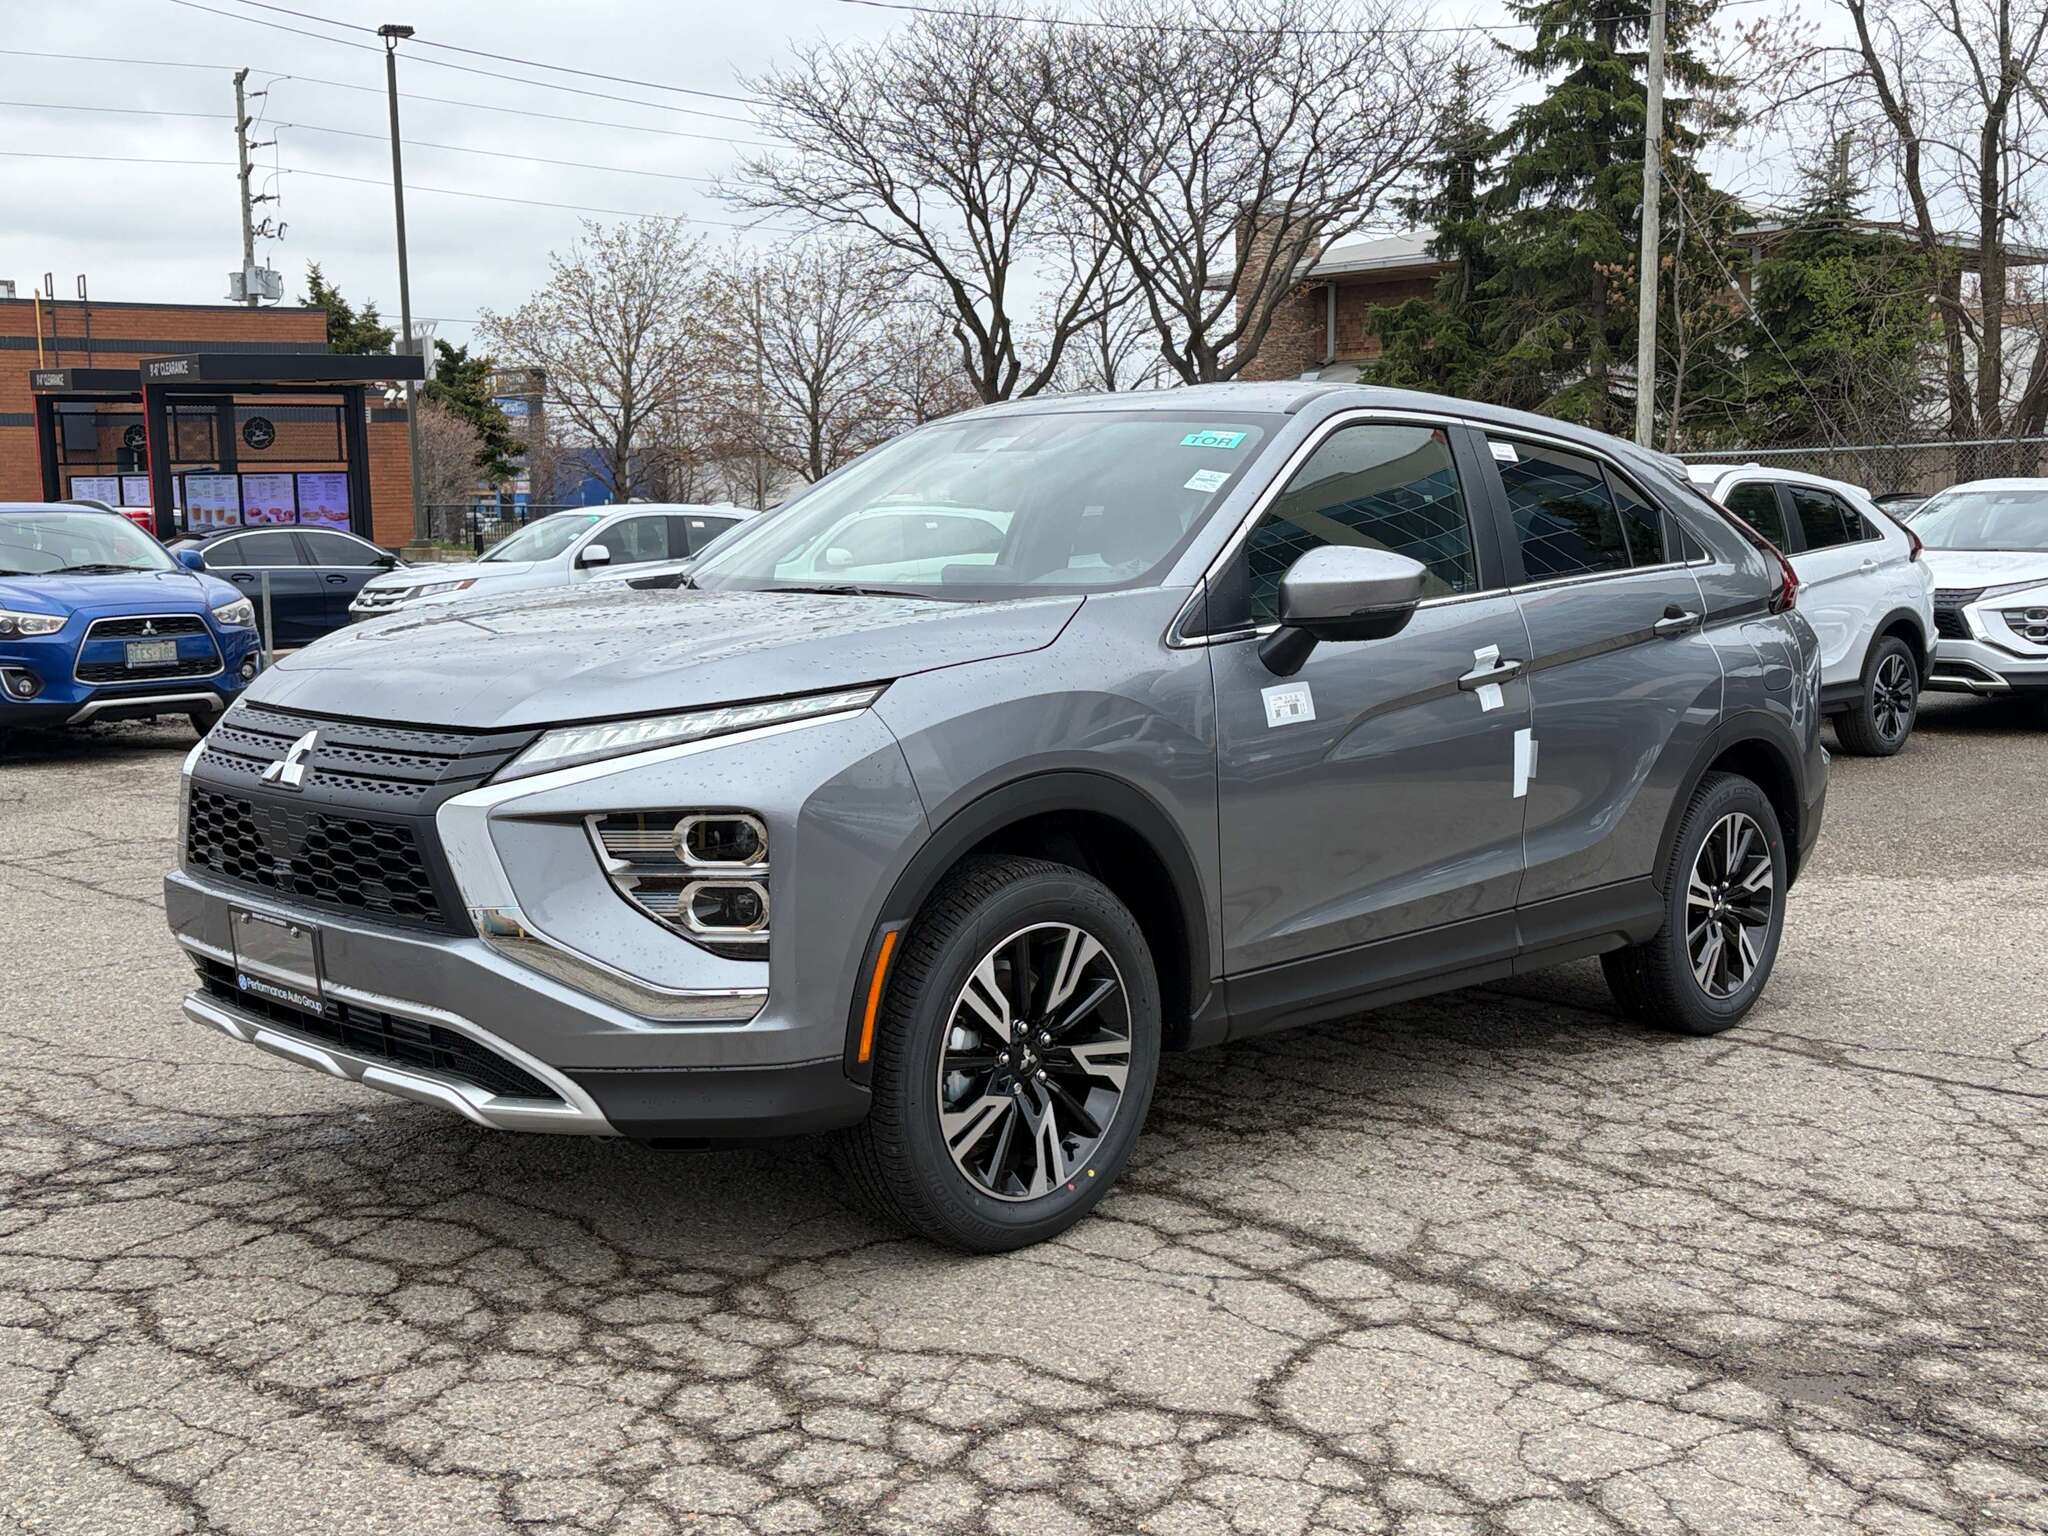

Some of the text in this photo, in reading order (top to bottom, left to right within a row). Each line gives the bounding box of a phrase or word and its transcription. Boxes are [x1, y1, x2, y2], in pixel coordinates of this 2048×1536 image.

[160, 360, 189, 376] CLEARANCE
[1191, 435, 1233, 447] TOR
[246, 977, 323, 1015] Performance Auto Group
